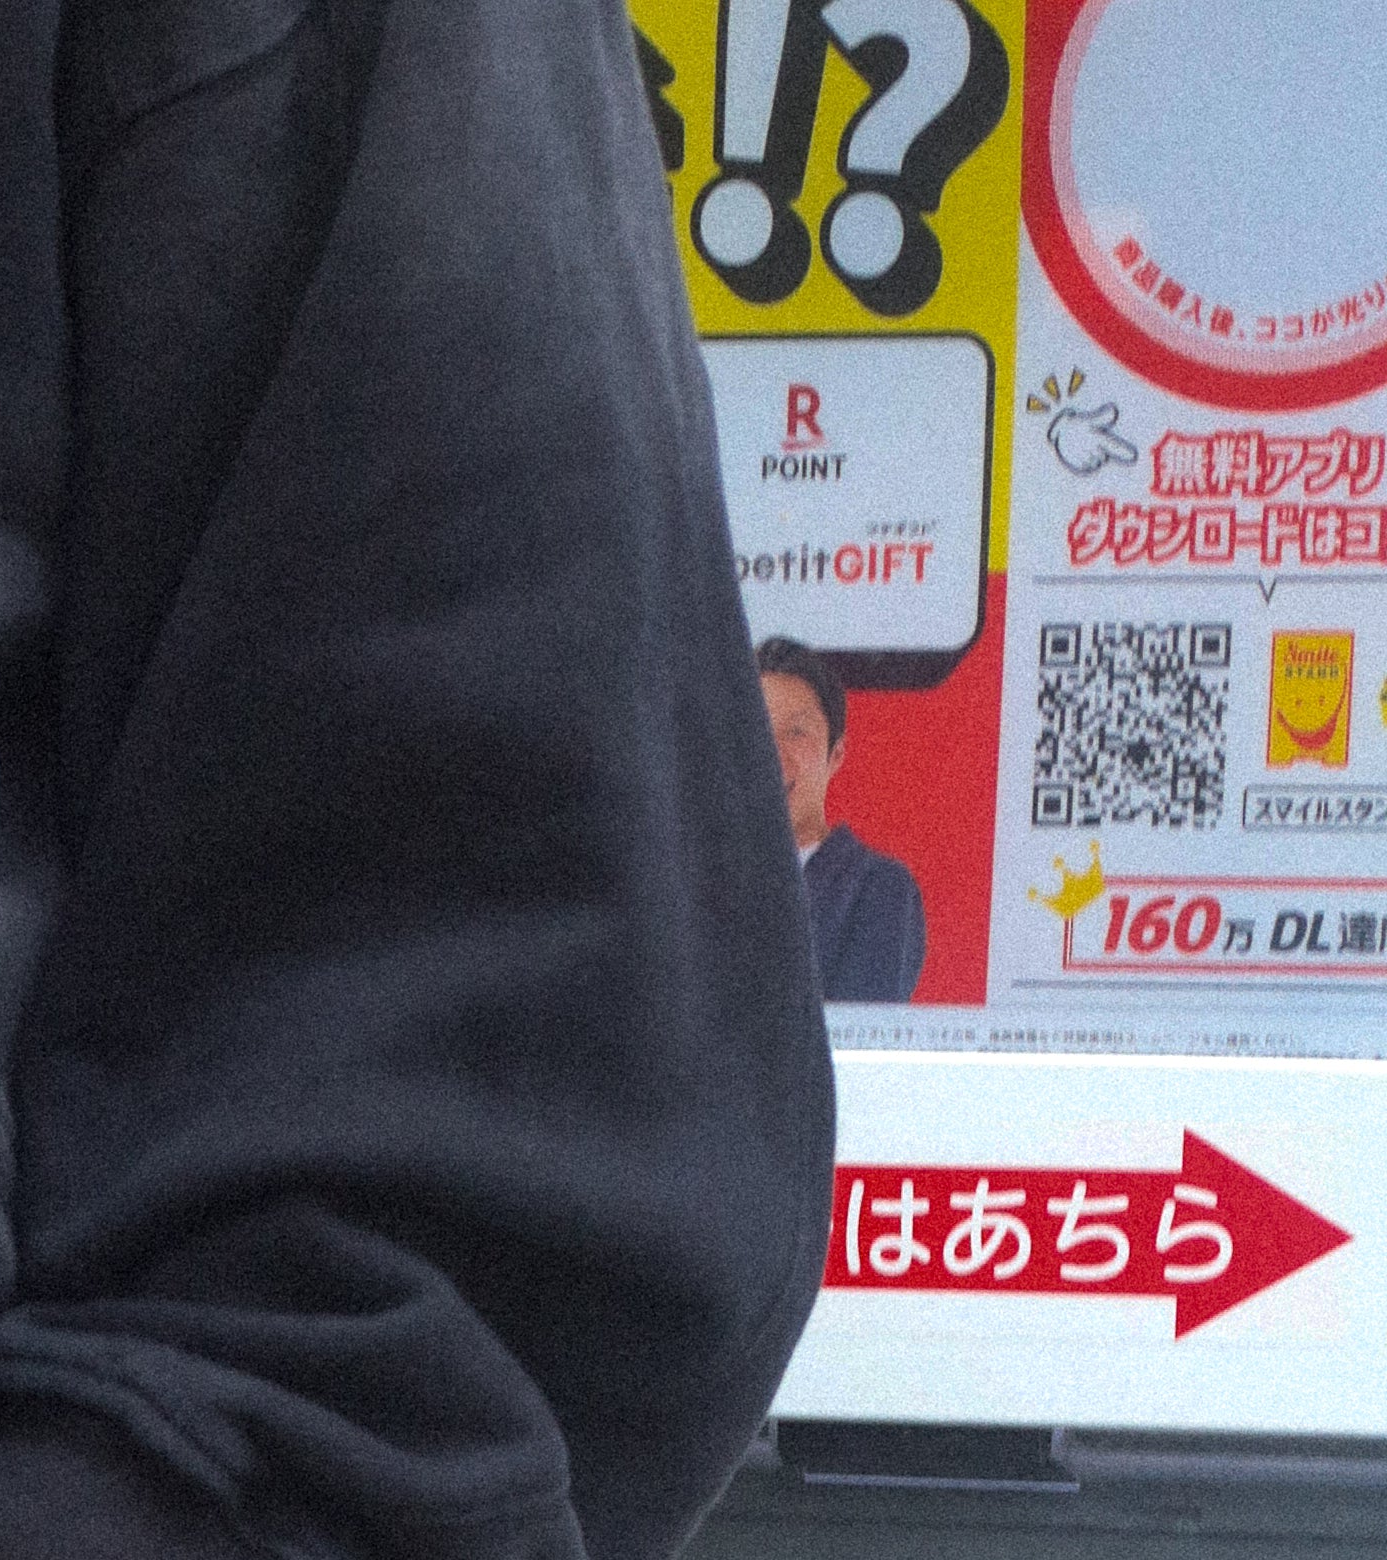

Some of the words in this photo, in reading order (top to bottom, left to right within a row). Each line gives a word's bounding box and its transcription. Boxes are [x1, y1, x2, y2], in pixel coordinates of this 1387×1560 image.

[761, 454, 846, 481] POINT
[1149, 428, 1385, 497] 無料アプリ
[829, 1178, 1233, 1283] はあちら
